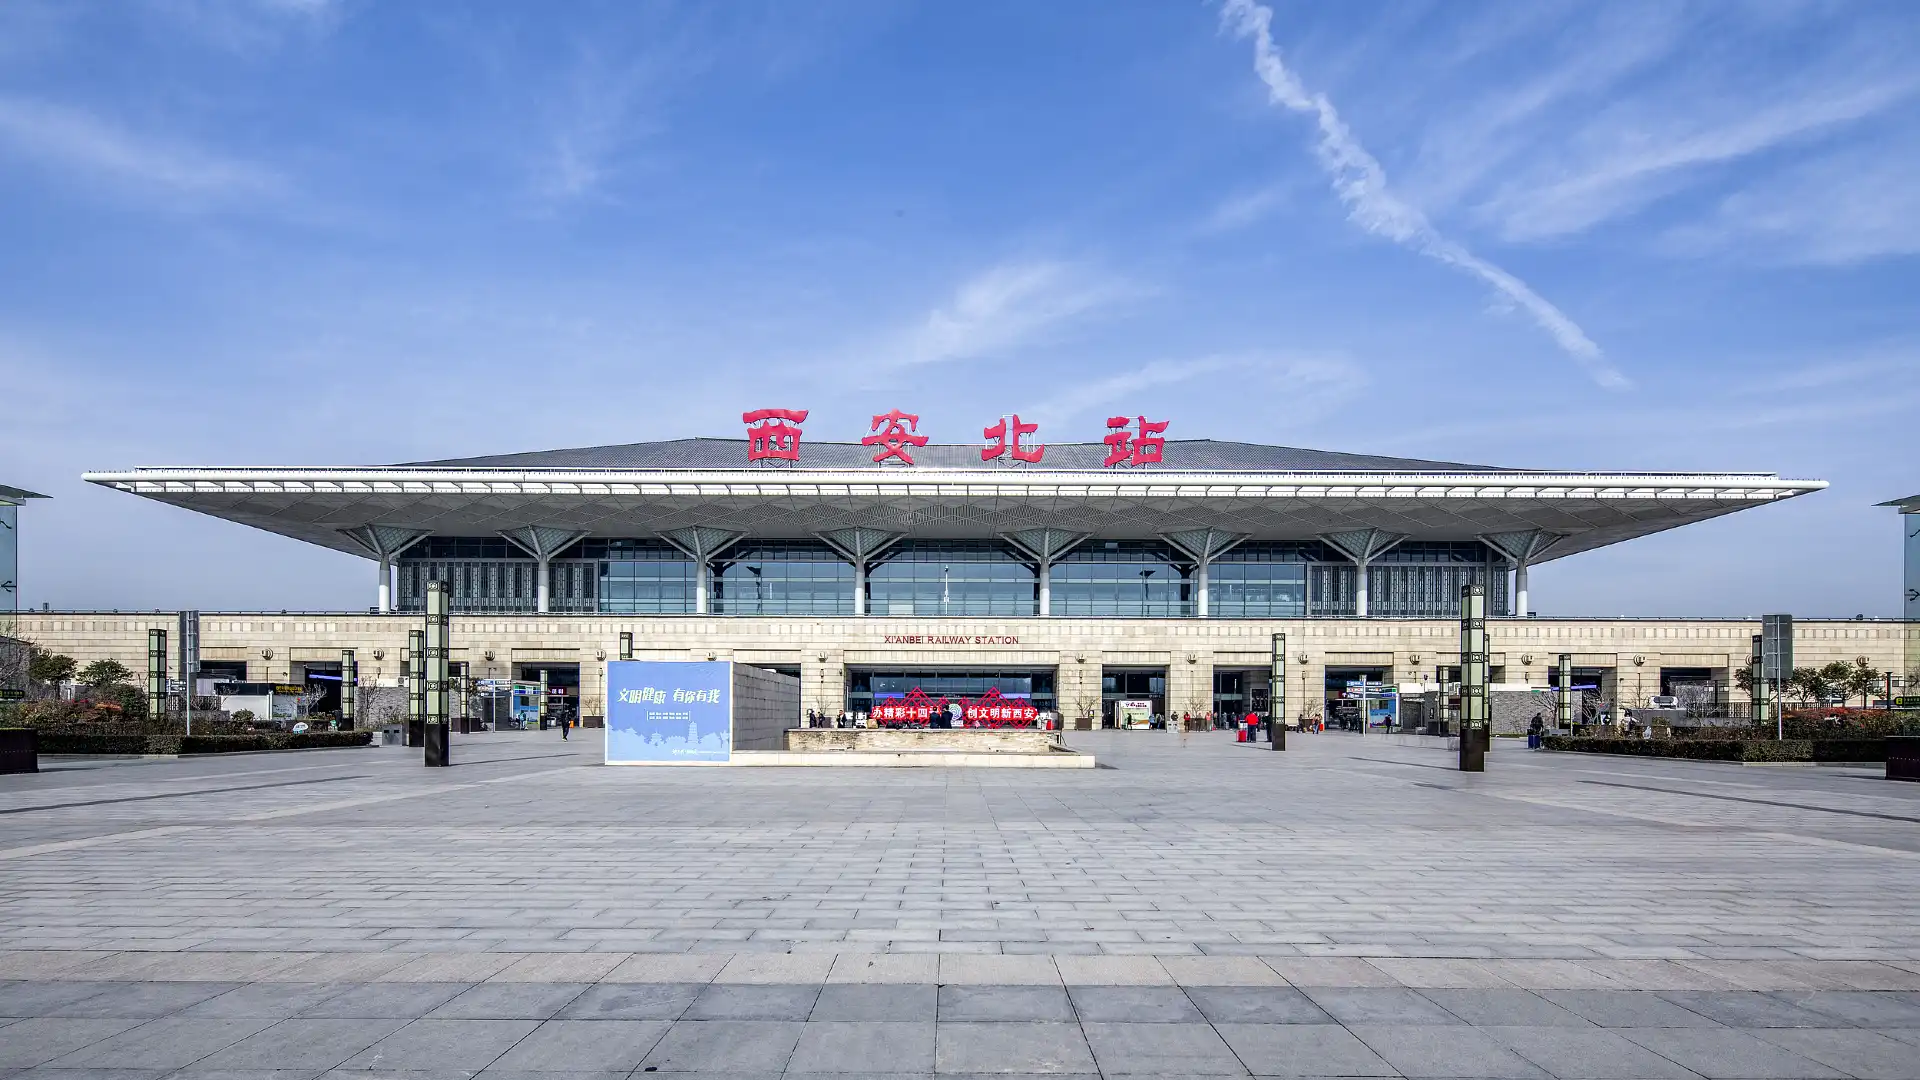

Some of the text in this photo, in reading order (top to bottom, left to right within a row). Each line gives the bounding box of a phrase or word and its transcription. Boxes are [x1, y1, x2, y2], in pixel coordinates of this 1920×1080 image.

[742, 409, 1170, 467] 西安北站
[884, 636, 1019, 645] XI'ANBEI RAILWAY STATION
[617, 687, 721, 705] 文明健康 有你有我
[967, 706, 1036, 720] 创文明新西安
